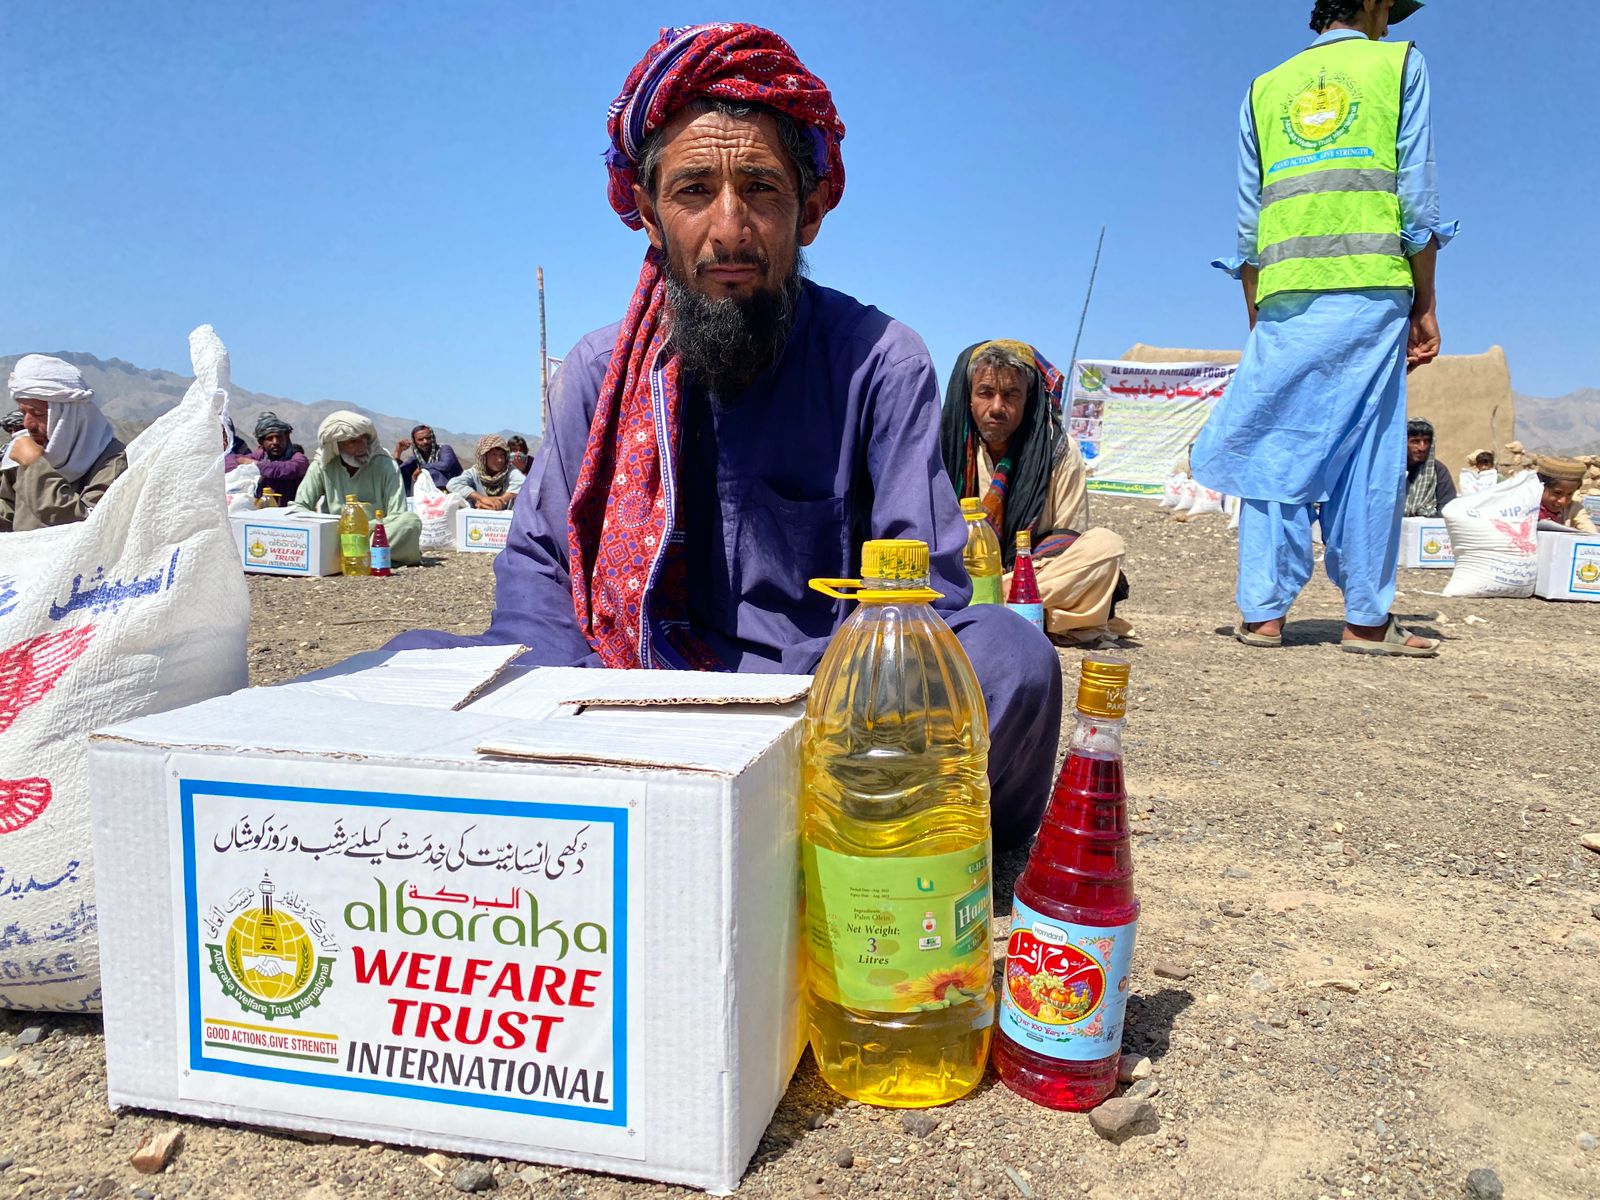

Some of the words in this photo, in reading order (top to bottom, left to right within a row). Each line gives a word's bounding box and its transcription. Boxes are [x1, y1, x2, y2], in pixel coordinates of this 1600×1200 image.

[1203, 367, 1226, 378] FOOD
[1499, 506, 1522, 517] VIP
[270, 548, 305, 556] WELFARE
[446, 825, 477, 872] کی
[343, 876, 608, 961] albaraka
[846, 923, 861, 934] Net
[865, 925, 901, 937] Weight:
[867, 937, 877, 953] 3
[1034, 926, 1064, 942] Hamdard
[858, 954, 889, 965] Litres
[212, 949, 235, 991] Albaraka
[234, 987, 268, 1014] Welfare
[269, 1005, 294, 1015] Trust
[294, 963, 330, 1011] International
[351, 946, 602, 1008] WELFARE
[387, 998, 565, 1053] TRUST
[1016, 1014, 1030, 1026] Over
[1031, 1023, 1043, 1032] 100
[1044, 1026, 1061, 1037] Years
[206, 1026, 230, 1041] GOOD
[291, 1038, 337, 1055] STRENGTH
[346, 1040, 609, 1104] INTERNATIONAL
